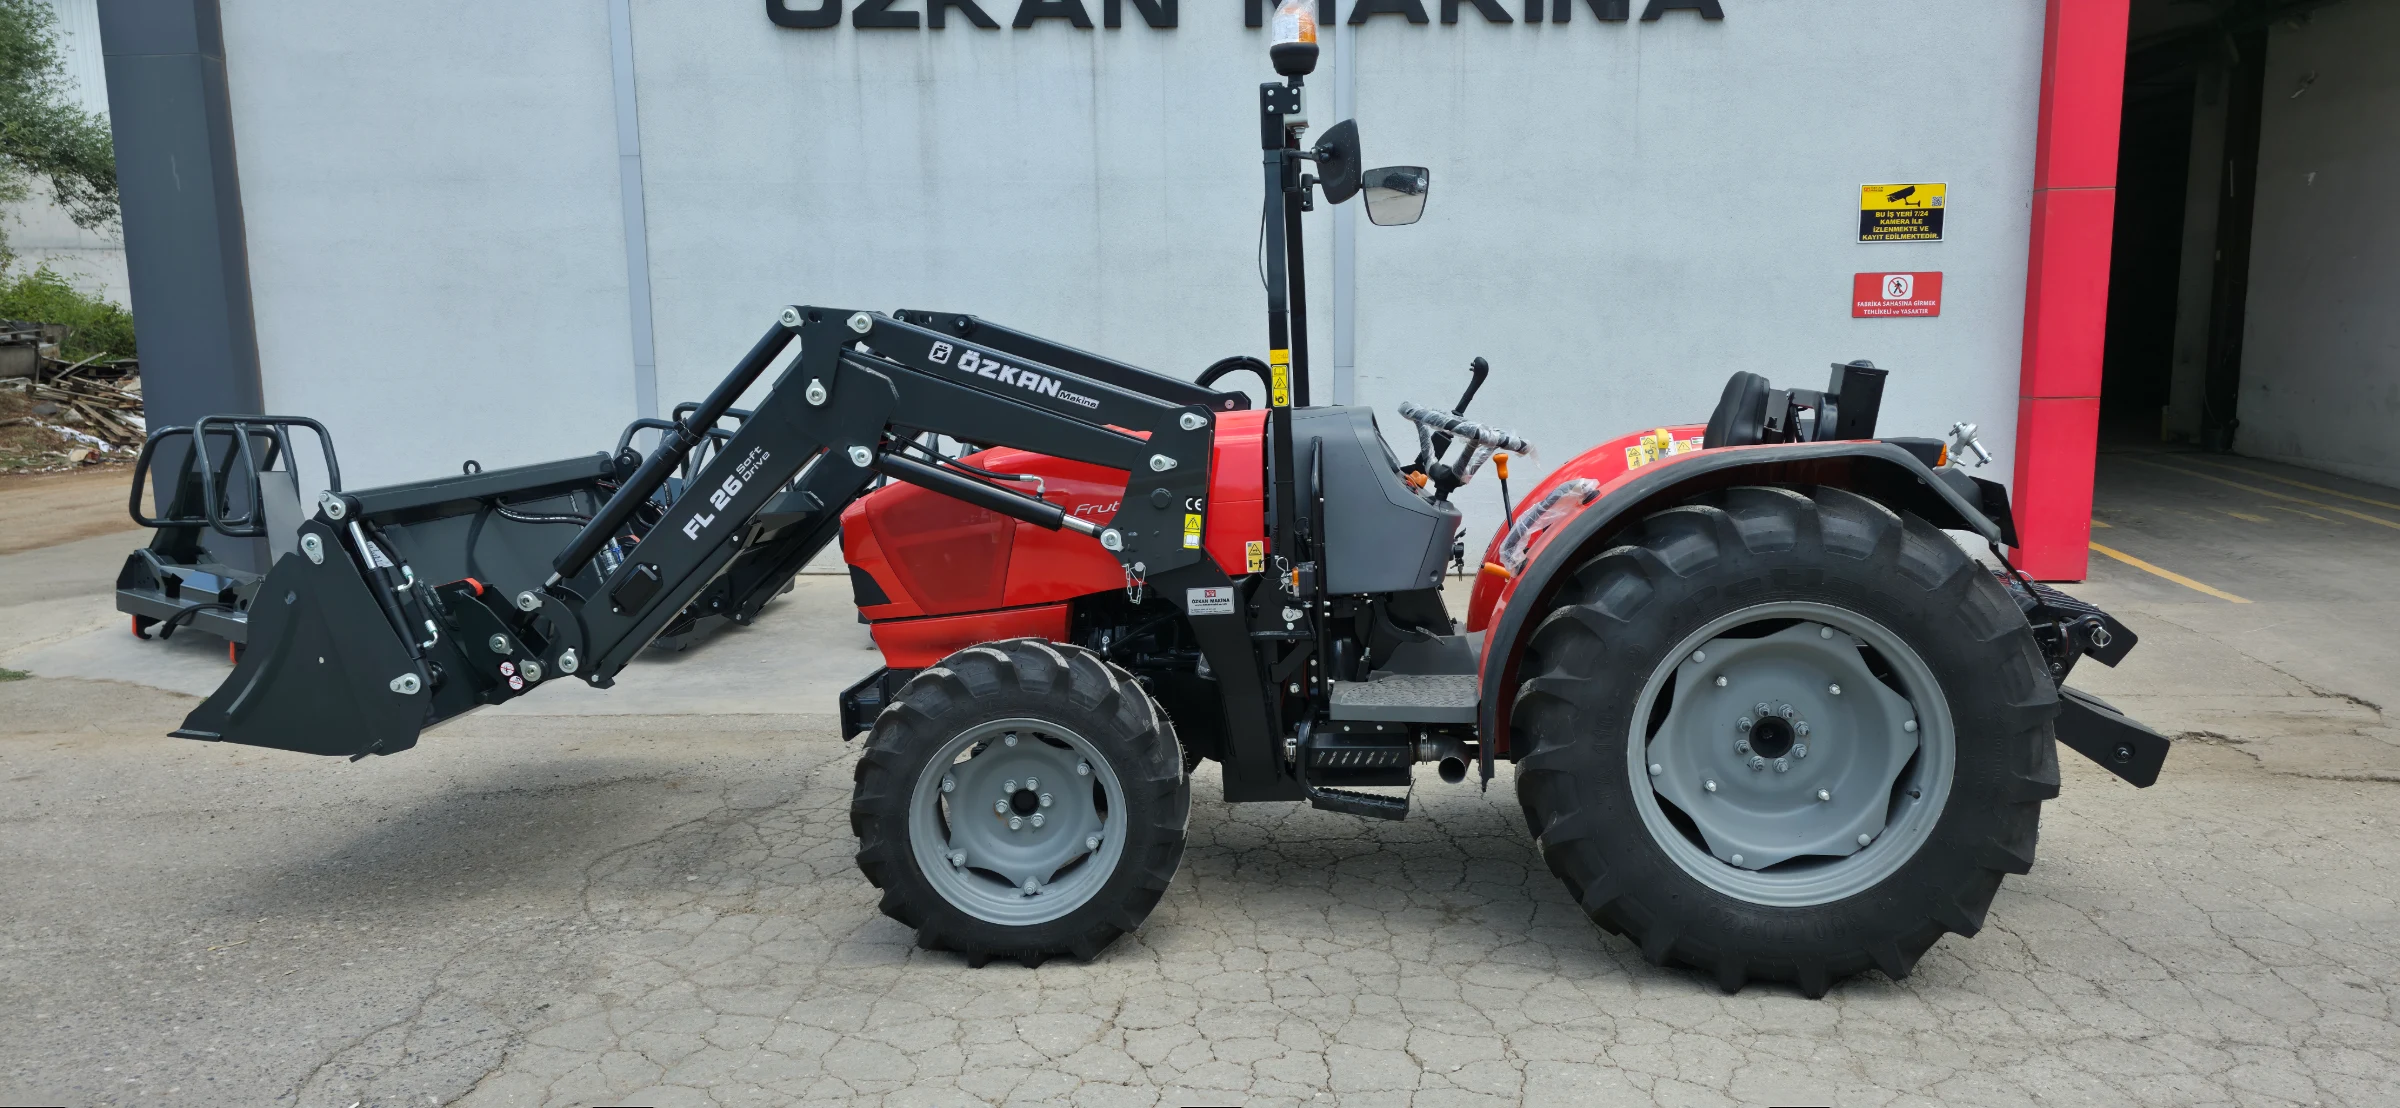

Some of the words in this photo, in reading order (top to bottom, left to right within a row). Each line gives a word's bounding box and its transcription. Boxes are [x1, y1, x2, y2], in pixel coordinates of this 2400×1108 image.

[1887, 210, 1895, 218] İŞ
[1873, 225, 1918, 233] İZLENMEKTE
[957, 349, 1062, 398] ÖZKAN
[1058, 390, 1099, 409] Makina
[735, 446, 762, 475] Soft
[741, 451, 771, 482] Drive
[682, 512, 716, 541] FL
[709, 474, 743, 512] 26
[1073, 500, 1120, 516] Frut
[1185, 497, 1203, 512] CE
